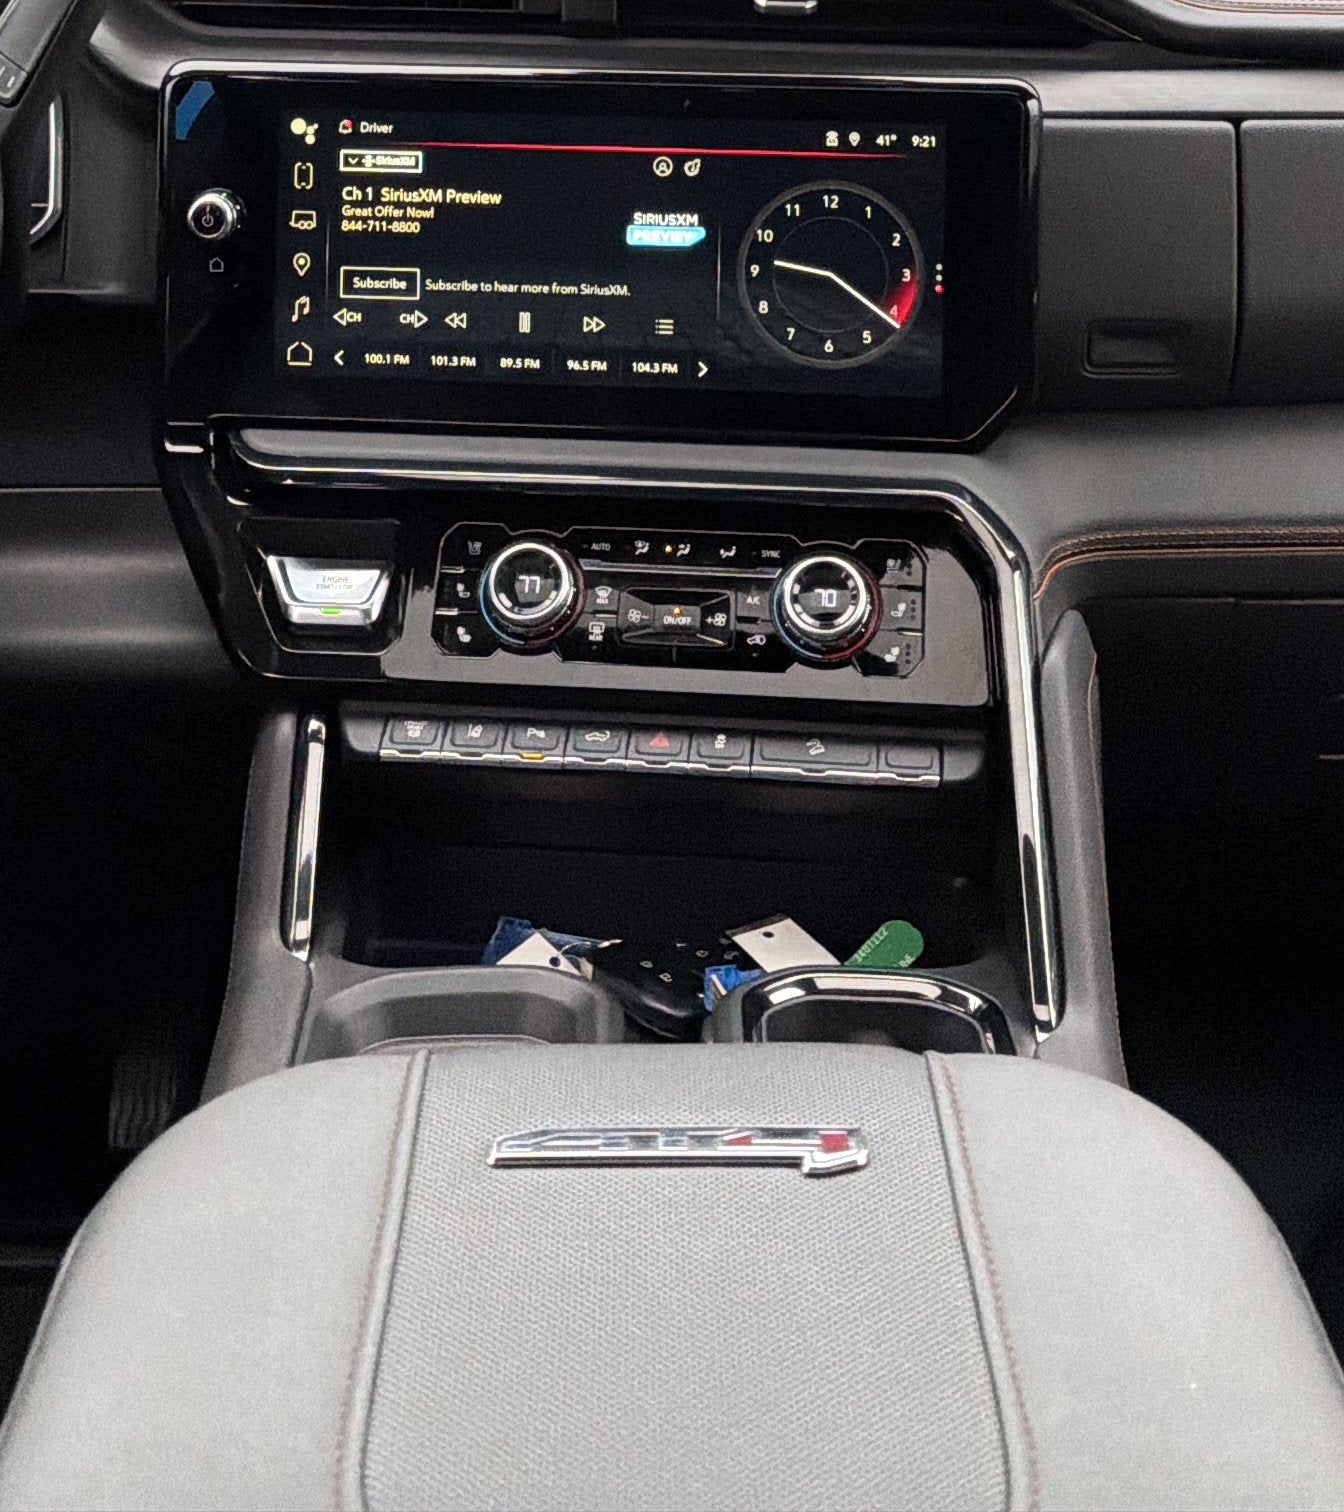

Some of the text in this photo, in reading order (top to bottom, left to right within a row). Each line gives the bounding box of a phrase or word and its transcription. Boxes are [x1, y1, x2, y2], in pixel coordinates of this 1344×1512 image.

[359, 121, 394, 134] Driver
[875, 134, 898, 147] 41°
[911, 135, 937, 148] 9:21
[375, 156, 416, 168] SiriusXM
[341, 186, 503, 204] Ch 1 SiriusXM Preview
[822, 195, 839, 209] 12
[341, 205, 435, 219] Great Offer Now!
[785, 203, 801, 216] 11
[864, 205, 872, 219] 1
[633, 212, 699, 226] SIRIUSXM
[341, 220, 421, 234] 844-711-8800
[756, 229, 774, 243] 10
[891, 233, 901, 247] 2
[750, 264, 760, 277] 9
[902, 268, 911, 282] 3
[352, 277, 407, 290] Subscribe
[425, 279, 631, 296] Subscribe to hear more from SiriusXM.
[758, 300, 769, 314] 8
[889, 304, 898, 318] 4
[347, 312, 362, 323] CH
[399, 313, 415, 324] CH
[786, 327, 795, 341] 7
[862, 330, 872, 344] 5
[824, 339, 834, 353] 6
[364, 354, 410, 365] 100.1 FM
[430, 355, 476, 367] 101.3 FM
[499, 357, 540, 369] 89.5 FM
[566, 359, 607, 372] 96.5 FM
[631, 362, 678, 374] 104.3 FM
[591, 543, 611, 552] AUTO
[761, 549, 781, 559] SYNC
[518, 575, 541, 594] 77
[746, 595, 761, 605] A/C
[814, 588, 837, 607] 70
[663, 616, 692, 626] ON/OFF
